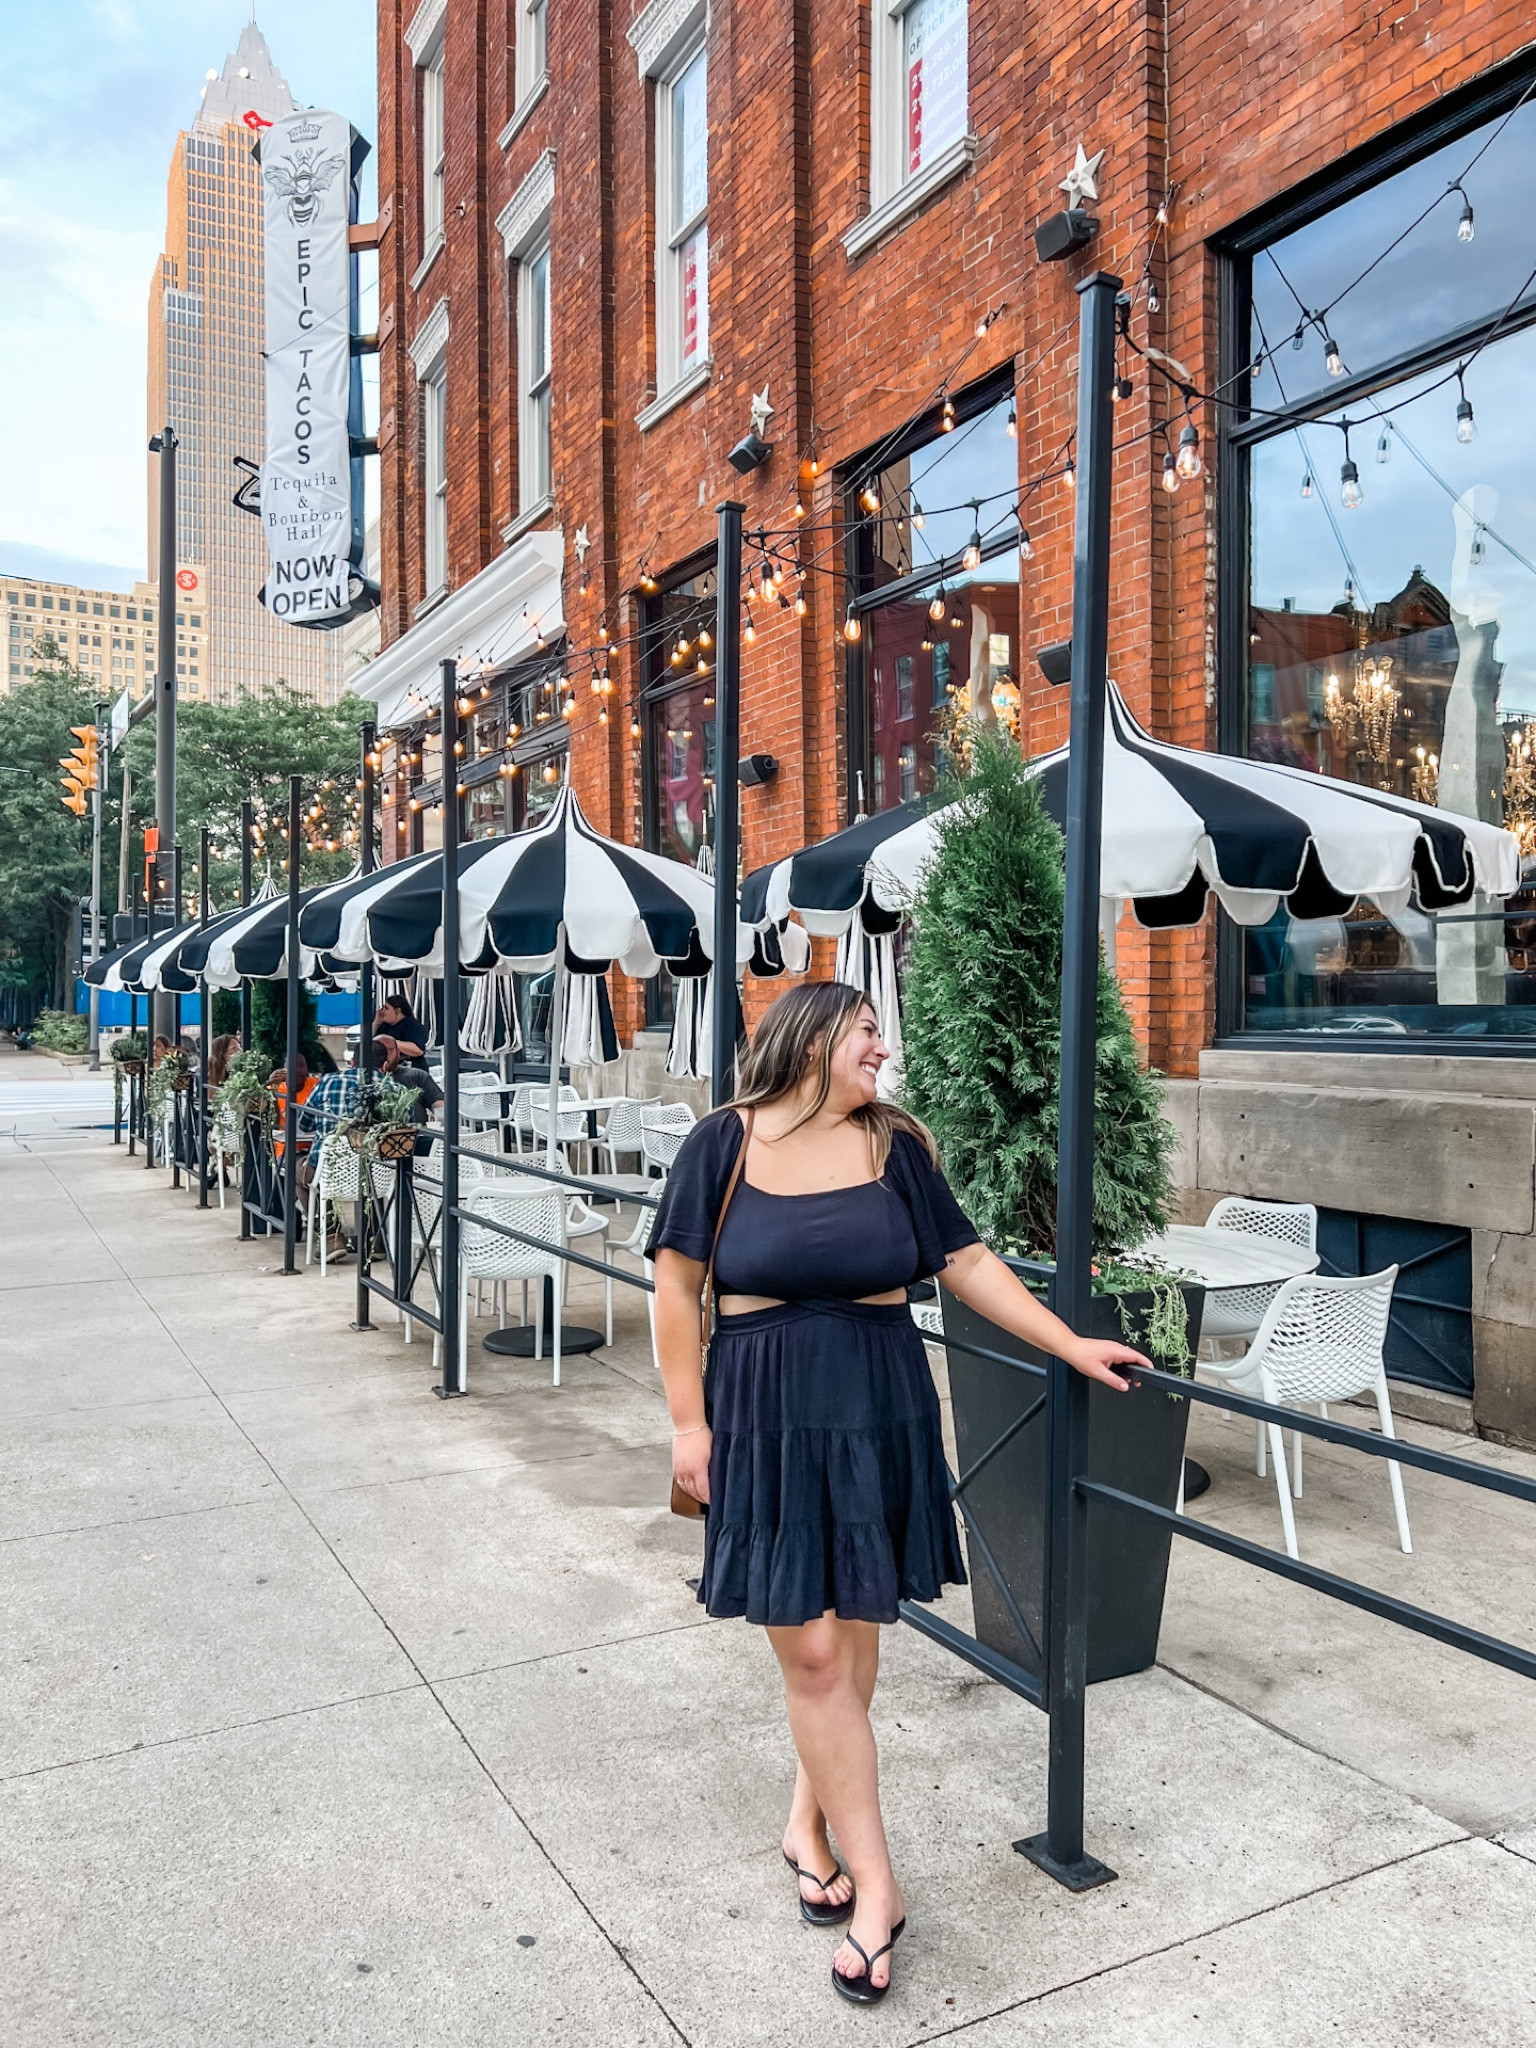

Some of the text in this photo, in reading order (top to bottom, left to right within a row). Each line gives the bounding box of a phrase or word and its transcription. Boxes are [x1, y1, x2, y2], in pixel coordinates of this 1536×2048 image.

[297, 239, 313, 330] EPIC
[294, 349, 313, 465] TACOS
[270, 472, 338, 494] Tequila
[297, 496, 310, 509] &
[269, 508, 343, 527] Bourbon
[286, 524, 323, 542] Hall
[275, 554, 337, 585] NOW
[45, 585, 151, 606] STANDAR
[272, 585, 341, 616] OPEN
